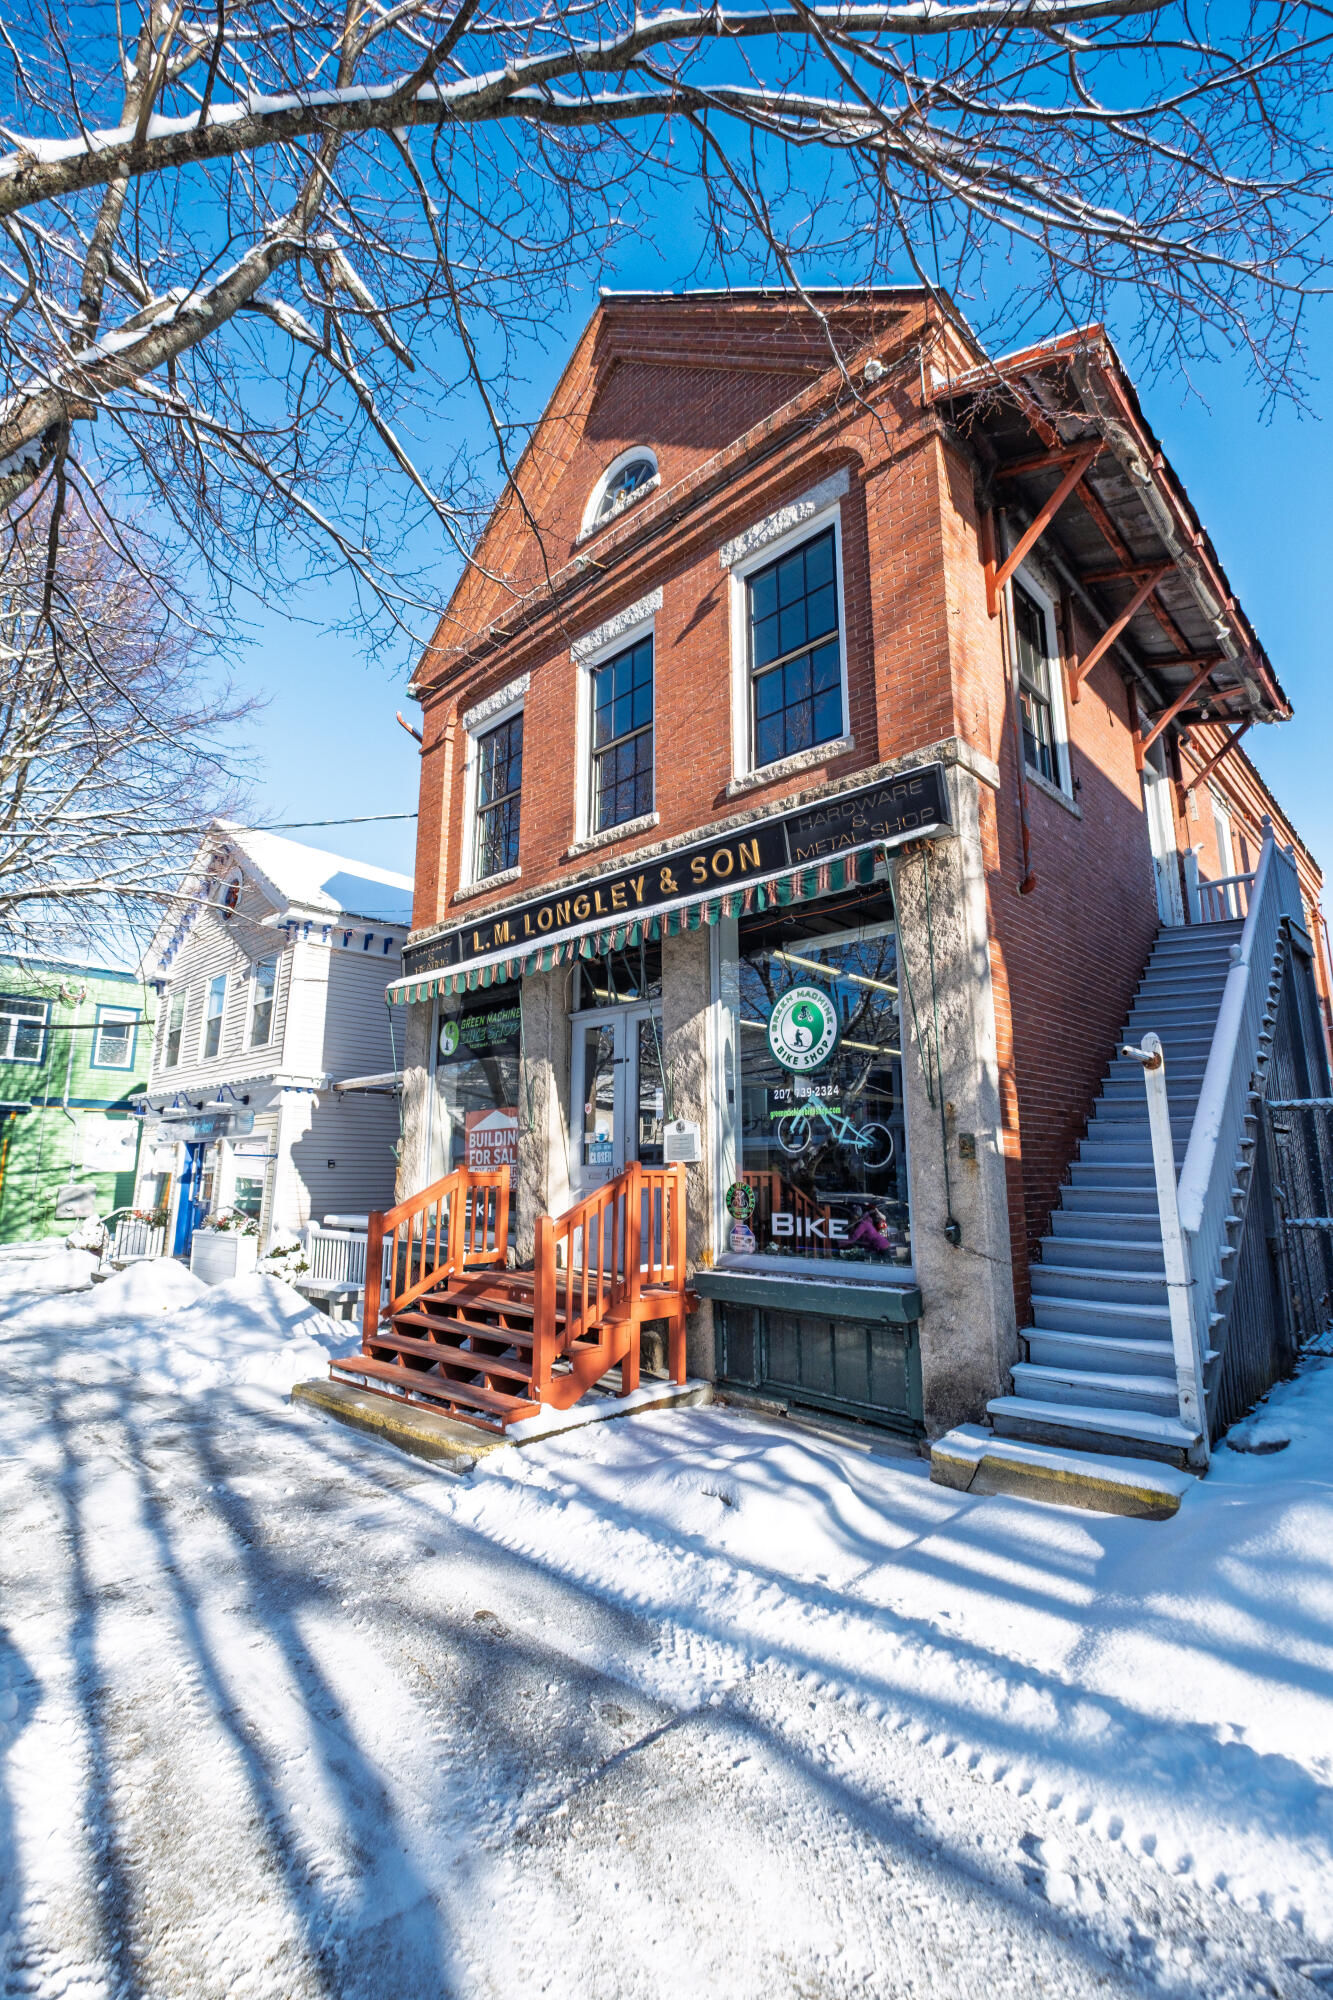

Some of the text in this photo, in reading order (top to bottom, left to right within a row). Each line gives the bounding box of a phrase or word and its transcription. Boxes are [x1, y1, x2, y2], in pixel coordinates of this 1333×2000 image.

[799, 778, 923, 833] HARDWARE
[852, 814, 867, 828] &
[796, 807, 935, 861] METAL SHOP
[523, 875, 645, 936] LONGLEY
[660, 866, 679, 894] &
[690, 838, 760, 884] SON
[460, 1008, 521, 1030] GREEN MACHINE
[772, 990, 834, 1032] GREEN MACHINE
[776, 1040, 829, 1065] BIKE SHOP
[774, 1085, 839, 1100] 207 739-2324
[469, 1129, 519, 1149] BUILDIN
[469, 1148, 517, 1165] FOR SAL
[590, 1151, 612, 1164] CLOSED
[771, 1212, 849, 1240] BIKE
